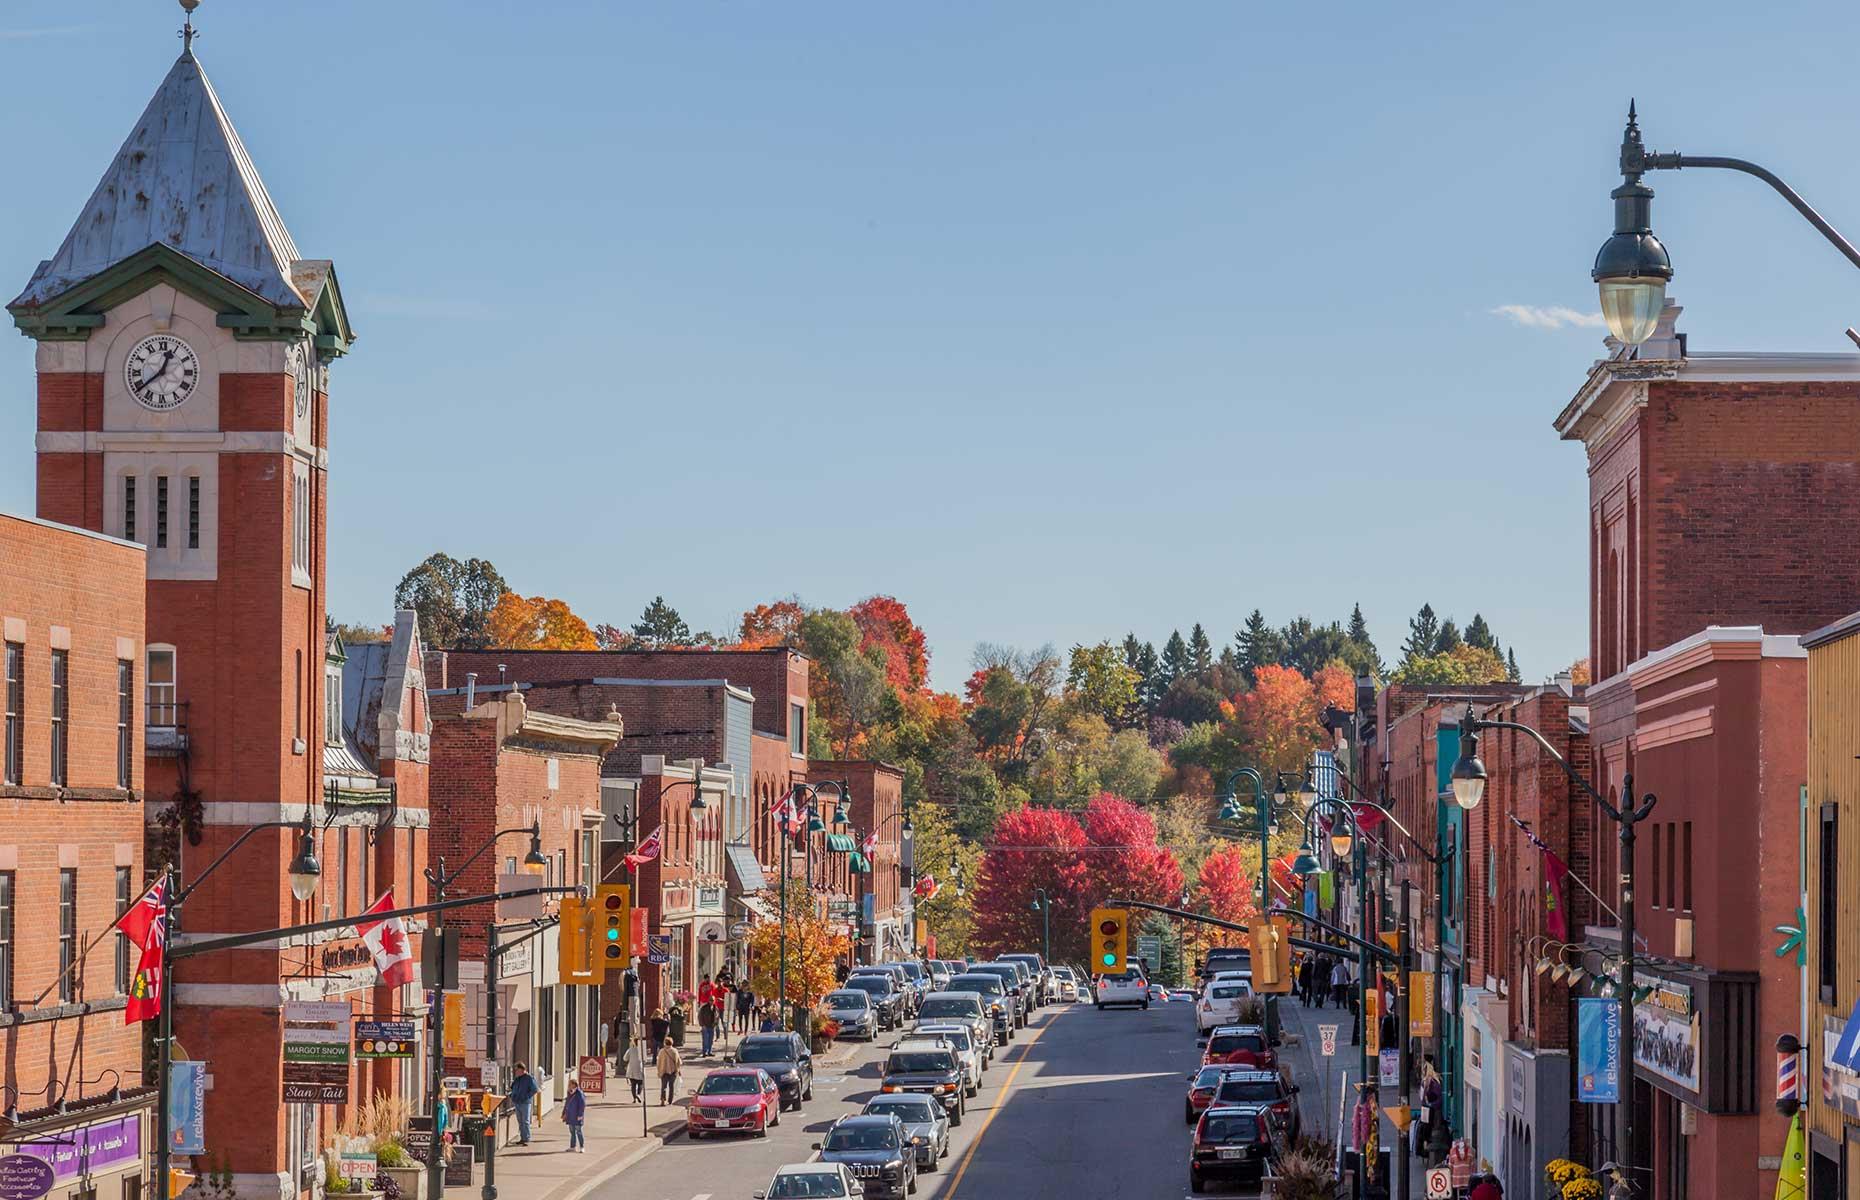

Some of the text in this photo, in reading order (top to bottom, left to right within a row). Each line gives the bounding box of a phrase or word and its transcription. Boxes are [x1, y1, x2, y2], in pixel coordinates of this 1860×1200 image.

[1323, 1031, 1334, 1041] 37
[1604, 1003, 1617, 1085] relax&revive
[287, 1046, 346, 1056] MARGOT SNOW
[580, 1080, 601, 1089] OPEN
[193, 1065, 205, 1139] relax&revive
[409, 1134, 431, 1142] OPEN
[341, 1162, 376, 1173] OPEN
